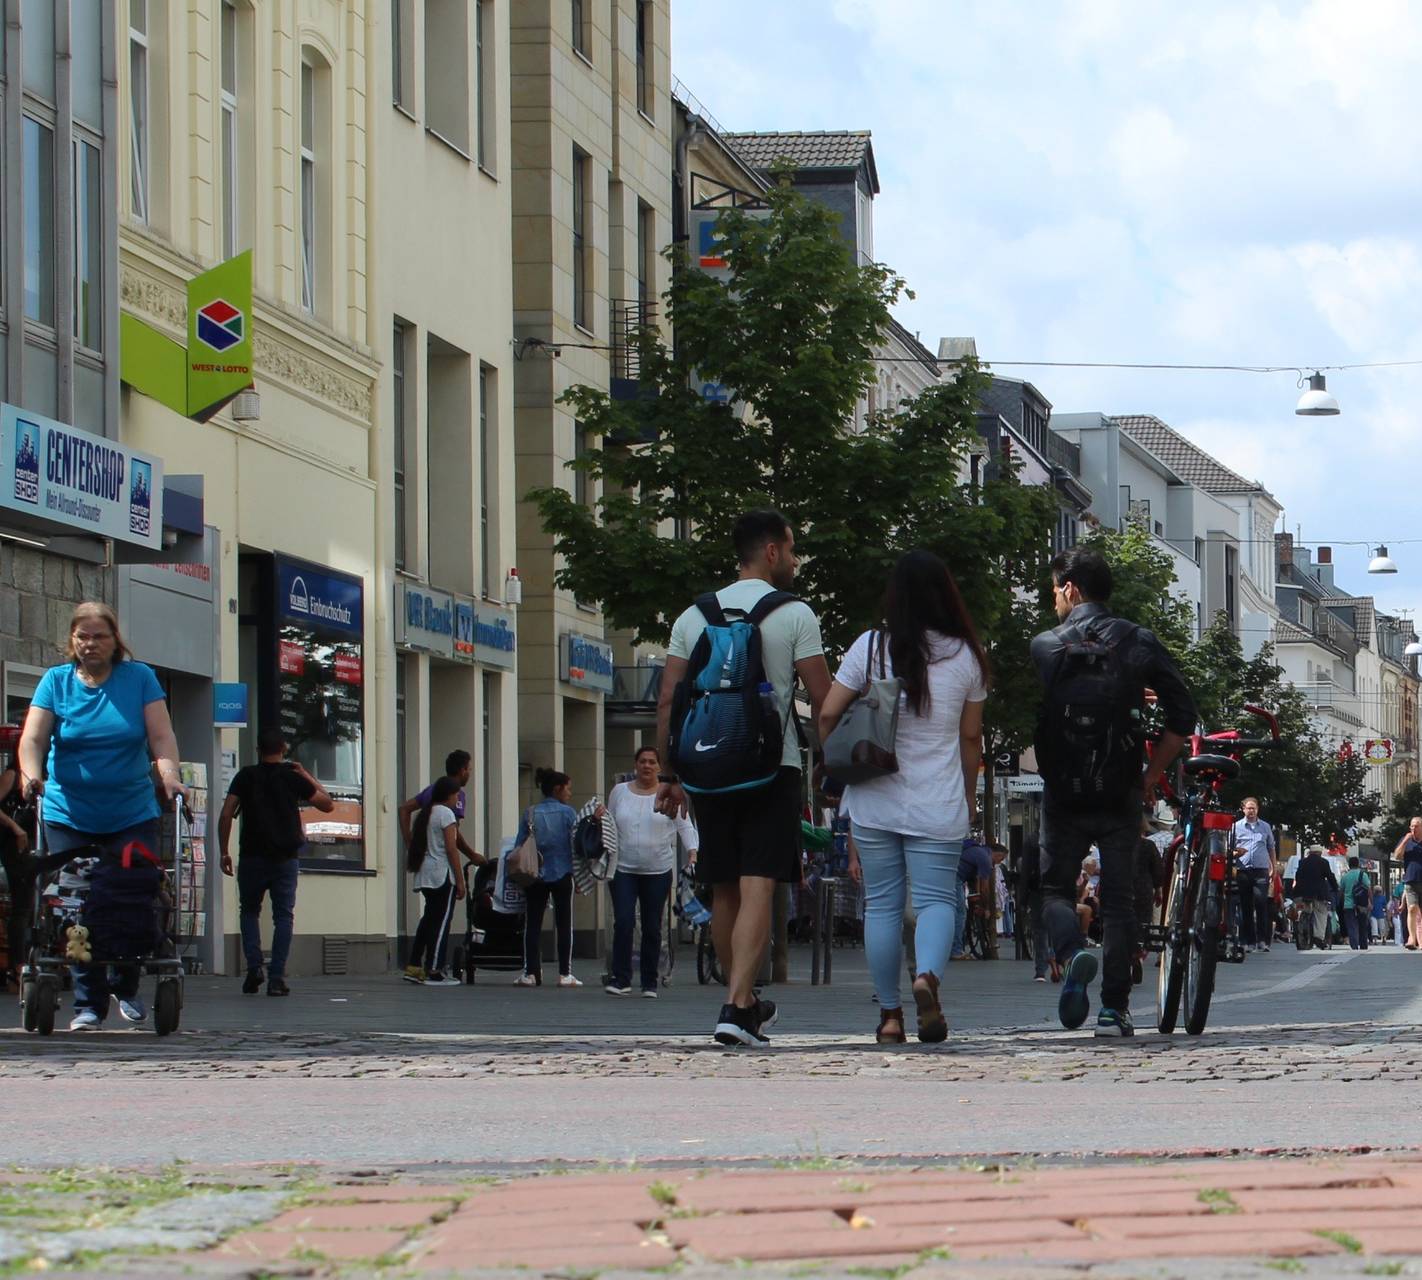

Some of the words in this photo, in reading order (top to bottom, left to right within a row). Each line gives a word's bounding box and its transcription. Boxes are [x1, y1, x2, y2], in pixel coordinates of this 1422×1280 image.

[191, 363, 214, 373] WEST
[222, 365, 249, 374] LOTTO
[16, 467, 39, 482] center
[46, 428, 124, 503] CENTERSHOP
[15, 479, 38, 498] SHOP
[130, 515, 150, 533] SHOP
[310, 596, 352, 625] Einbruchschutz
